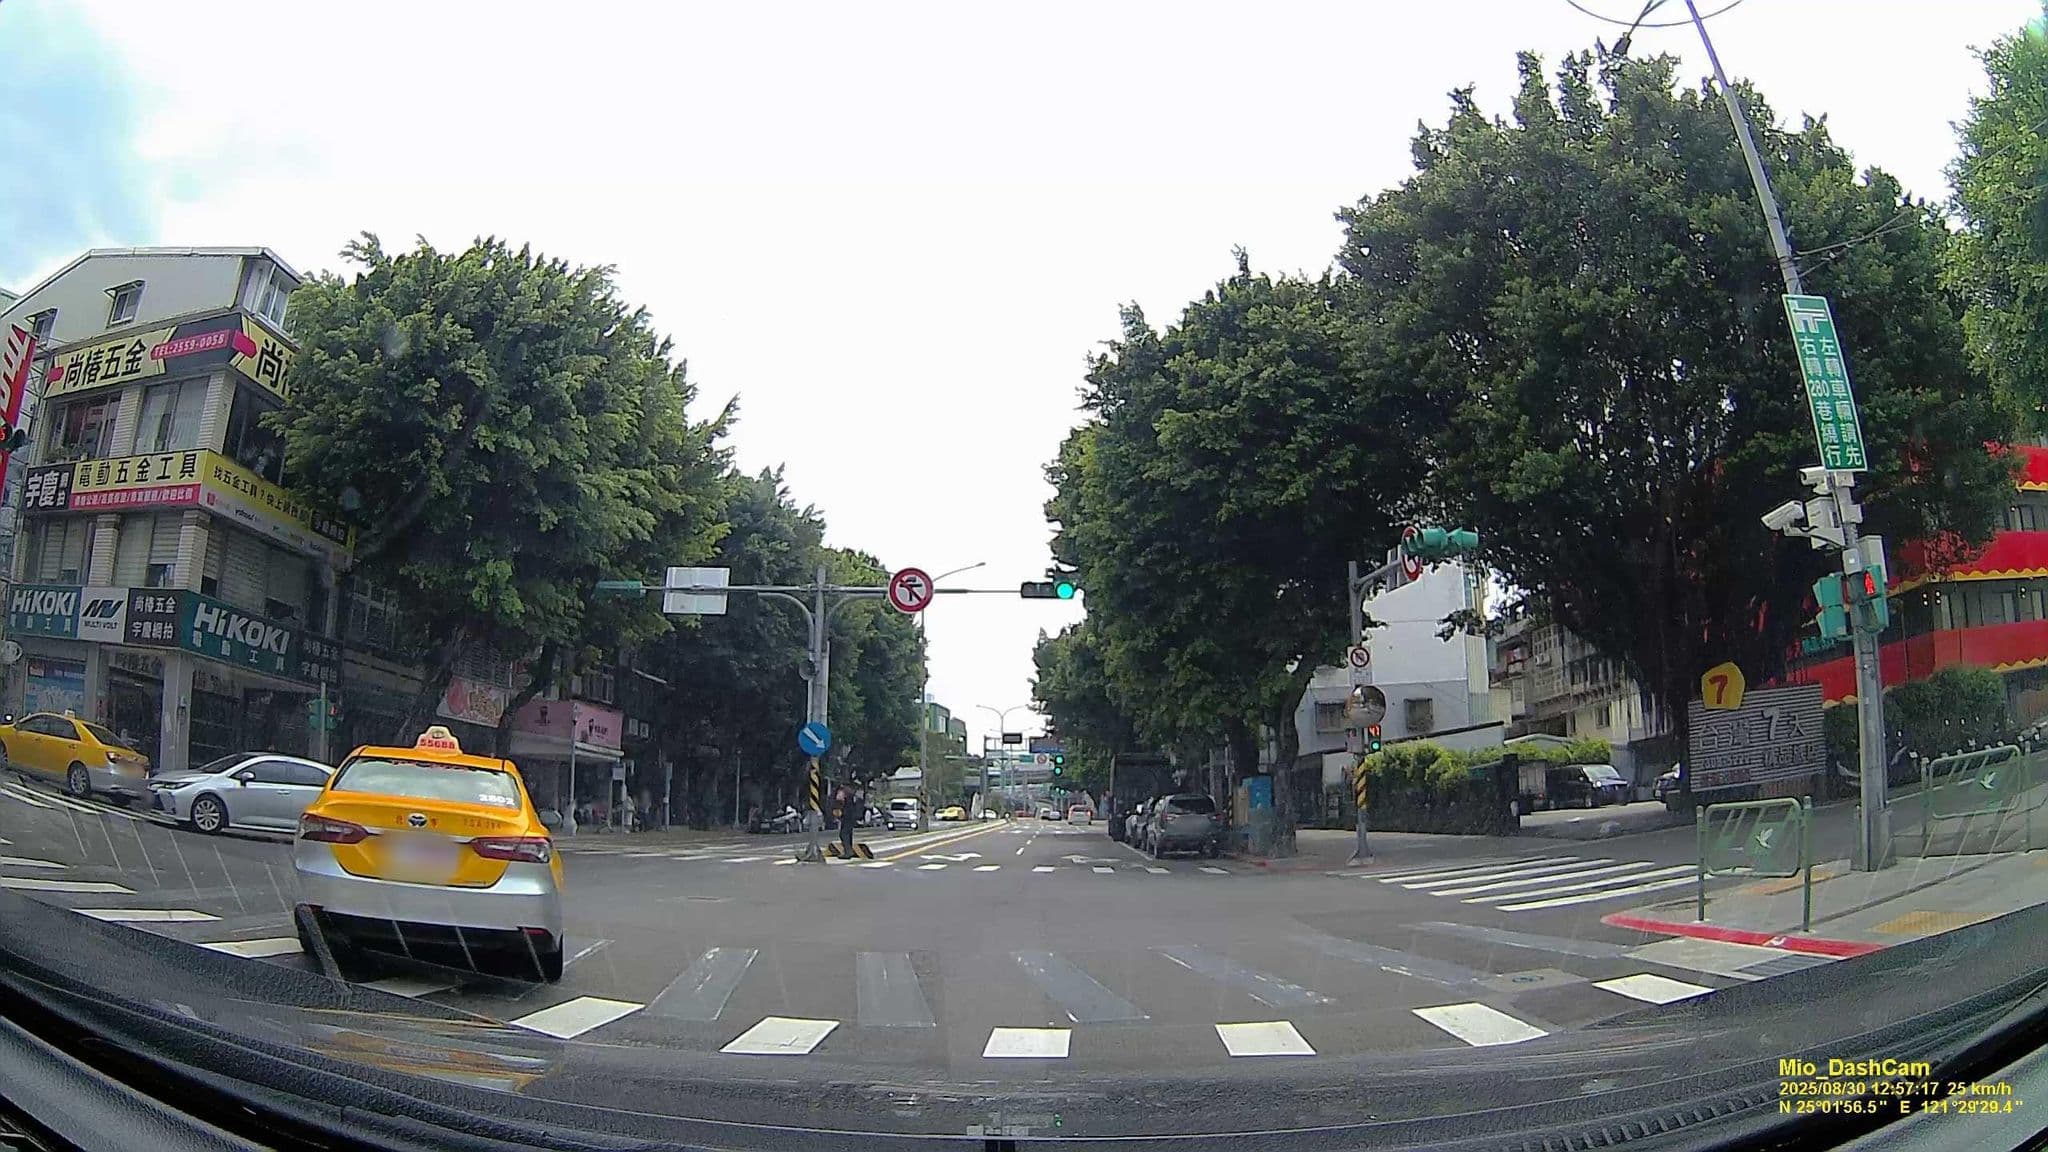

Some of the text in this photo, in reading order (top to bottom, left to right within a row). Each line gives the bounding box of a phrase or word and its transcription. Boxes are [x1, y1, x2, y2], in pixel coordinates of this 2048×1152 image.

[63, 339, 147, 389] 尚椿五金
[1819, 336, 1862, 466] 左轉車輛請先
[78, 453, 198, 488] 電動五金工具
[11, 589, 77, 616] HiKOKI
[194, 602, 290, 655] HiKOKI
[1708, 674, 1729, 704] 7
